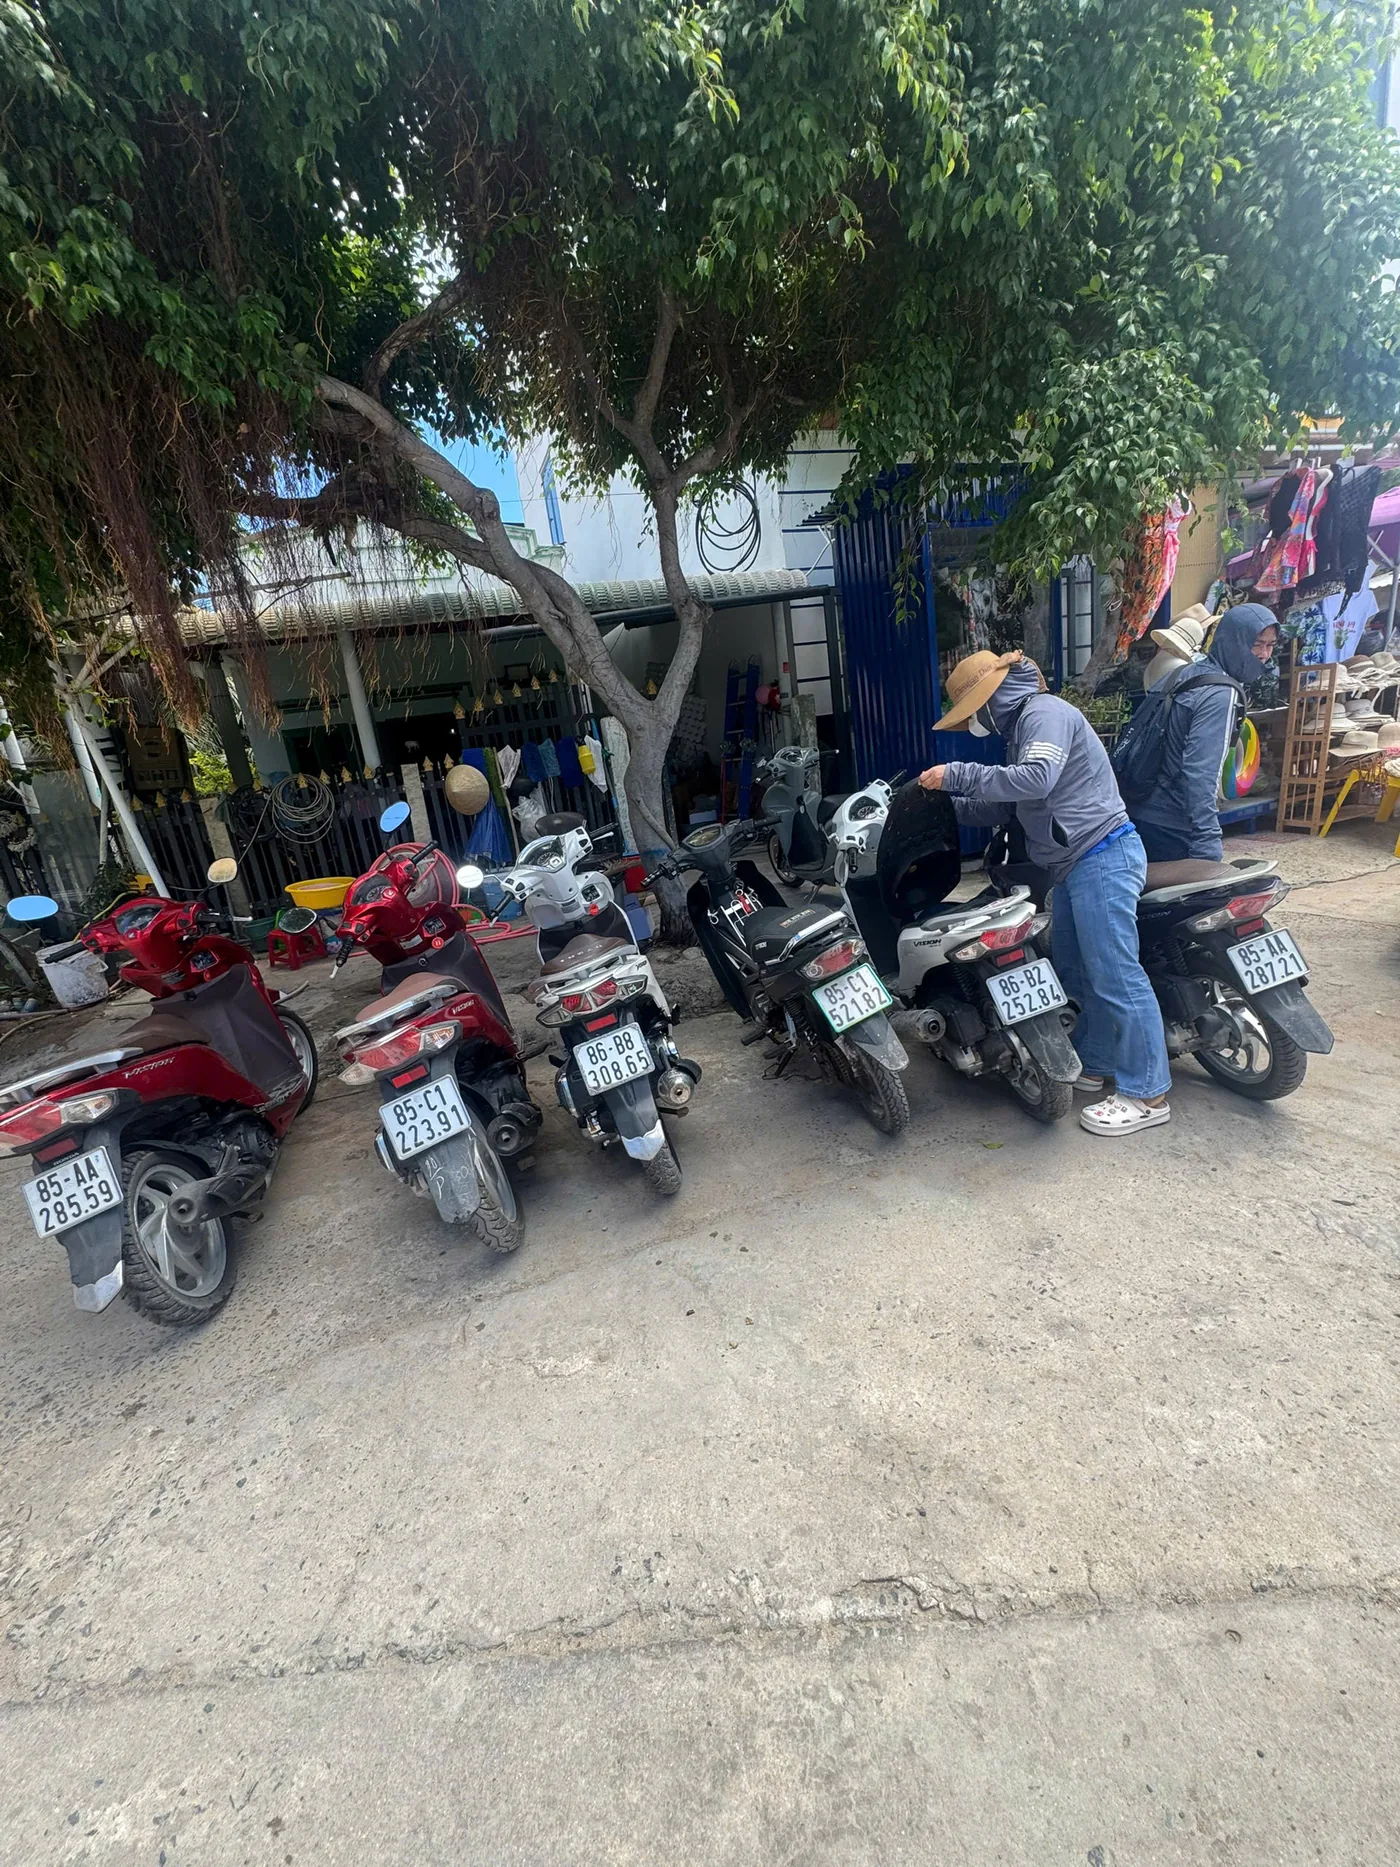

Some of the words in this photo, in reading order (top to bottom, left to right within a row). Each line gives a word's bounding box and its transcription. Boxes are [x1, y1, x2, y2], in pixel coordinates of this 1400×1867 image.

[979, 664, 993, 677] Dior
[913, 938, 942, 948] VISION
[1237, 934, 1288, 967] 85-AA
[823, 971, 868, 1005] 85-C1
[998, 966, 1047, 997] 86-B2
[1244, 952, 1303, 990] 287.21
[828, 986, 887, 1027] 521.82
[1001, 984, 1061, 1020] 252.84
[586, 1031, 634, 1065] 86-B8
[587, 1049, 649, 1089] 308.65
[393, 1084, 447, 1125] 85-C1
[396, 1104, 464, 1154] 223.91
[36, 1156, 99, 1203] 85-AA
[39, 1179, 113, 1233] 285.59
